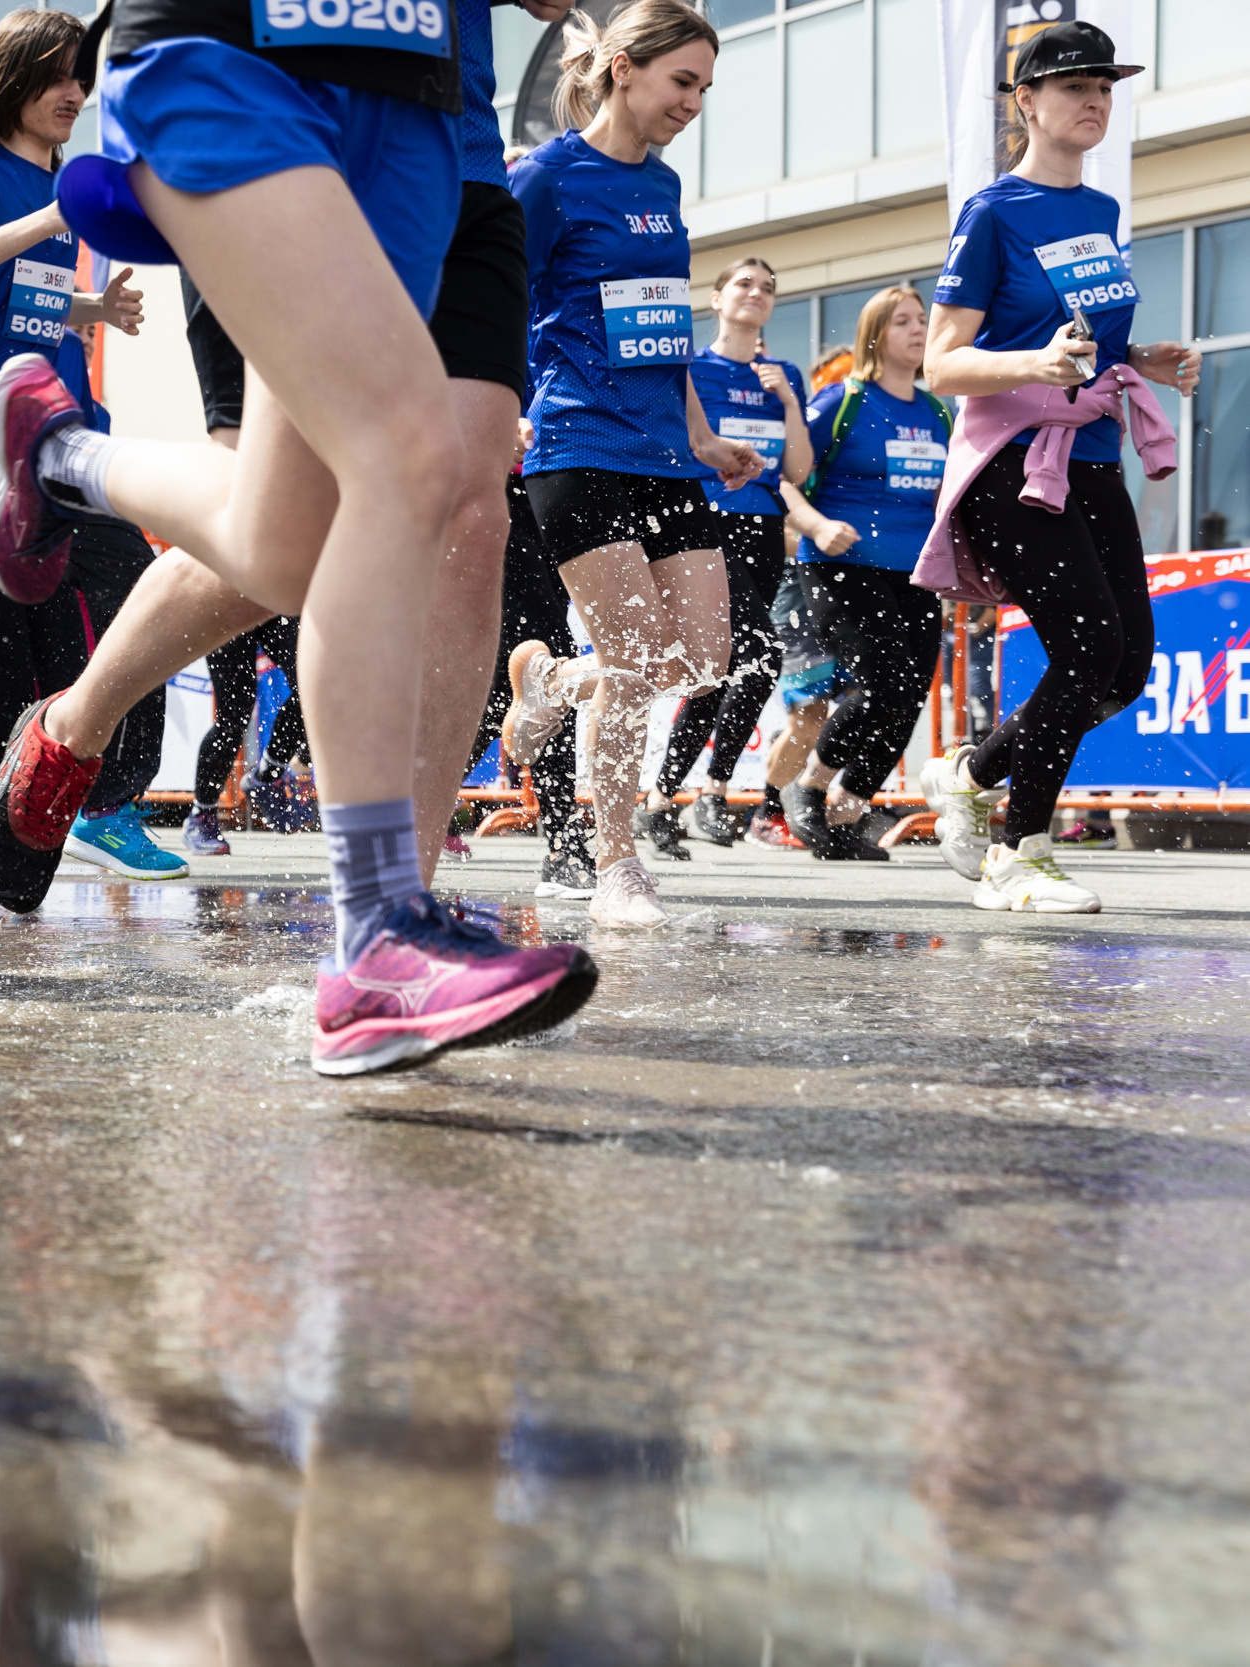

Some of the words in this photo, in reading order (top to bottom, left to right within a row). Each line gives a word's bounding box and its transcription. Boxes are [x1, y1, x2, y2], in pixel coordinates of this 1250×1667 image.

[266, 0, 443, 39] 50209
[1064, 281, 1136, 309] 50503
[619, 336, 689, 359] 50617
